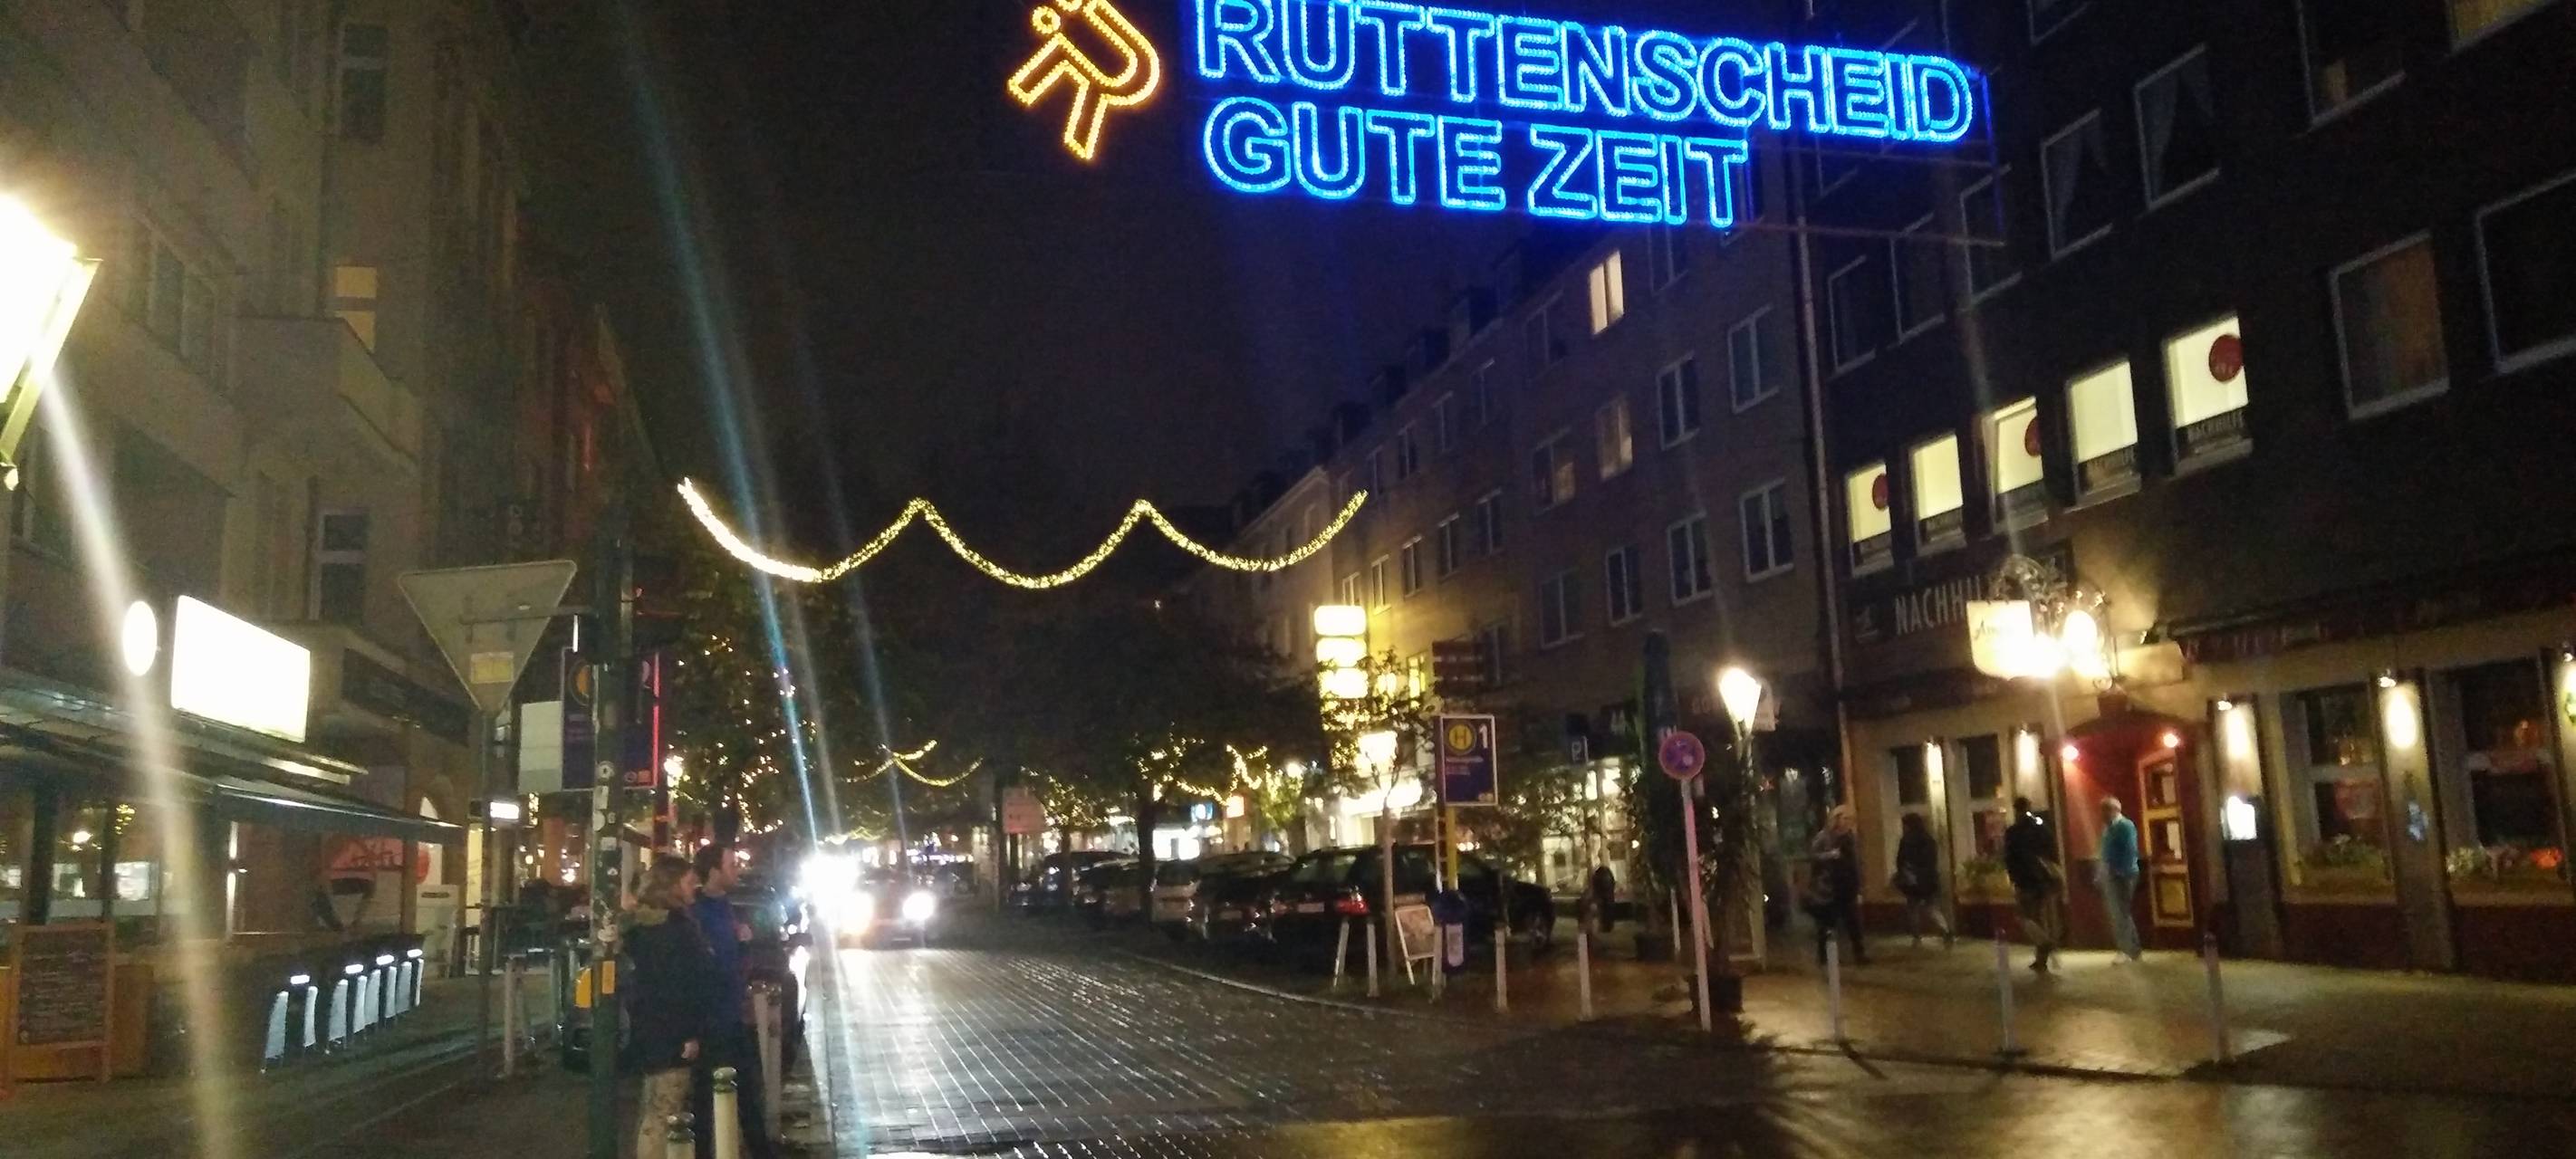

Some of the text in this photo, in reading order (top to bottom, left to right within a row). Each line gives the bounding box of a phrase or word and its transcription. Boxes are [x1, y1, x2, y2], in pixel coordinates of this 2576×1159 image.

[1204, 96, 1748, 228] GUTE ZEIT
[1479, 724, 1488, 749] 1
